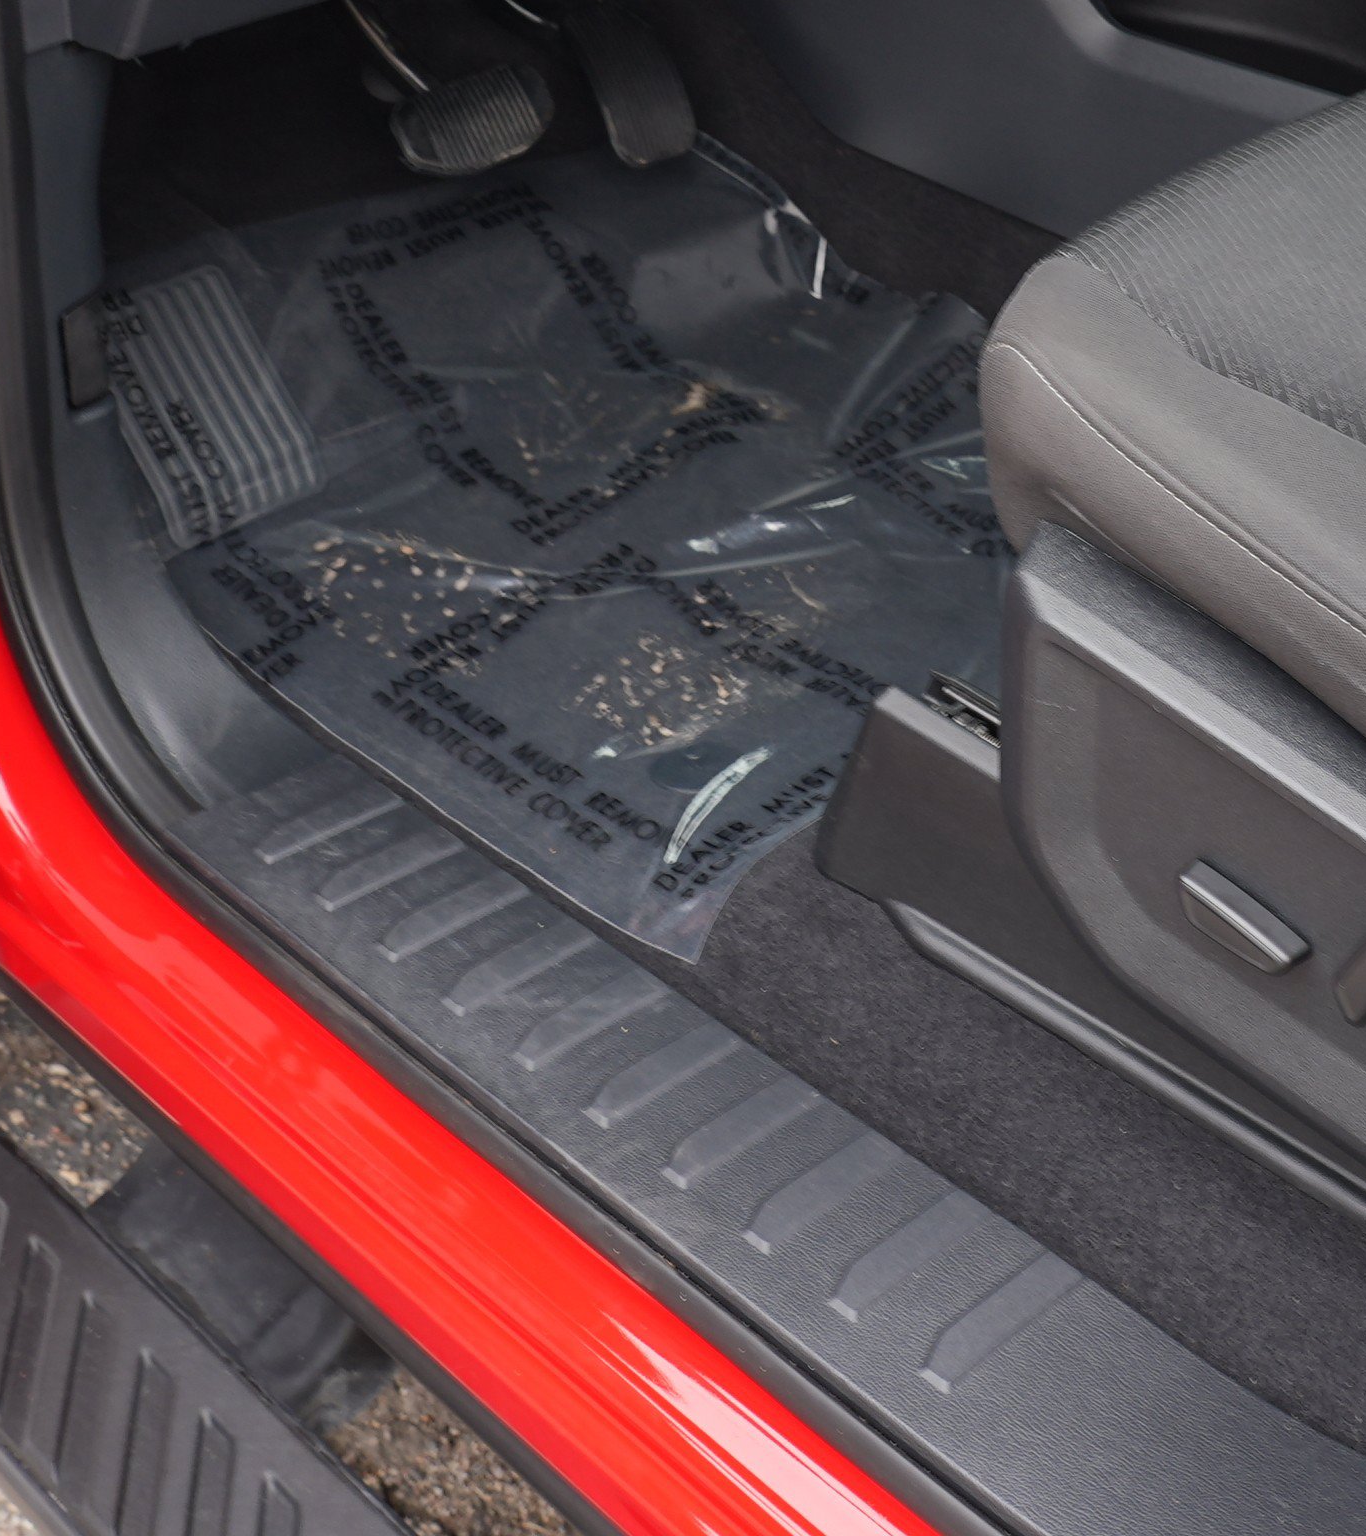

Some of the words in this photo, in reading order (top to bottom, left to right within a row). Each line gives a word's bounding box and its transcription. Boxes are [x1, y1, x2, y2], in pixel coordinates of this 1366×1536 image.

[326, 283, 427, 410] PROTECTIVE
[411, 419, 476, 492] COVER
[341, 279, 410, 369] DEALER
[412, 366, 467, 440] MUST
[164, 399, 223, 481] COVER
[509, 485, 592, 535] DEALER
[405, 609, 491, 663] COVER
[776, 636, 889, 696] OTECTIVE
[396, 697, 531, 797] PROTECTIVE
[526, 790, 613, 852] COVER
[420, 677, 508, 741] DEALER
[509, 741, 585, 790] MUST
[583, 791, 668, 845] REMO
[651, 820, 753, 892] DEALER
